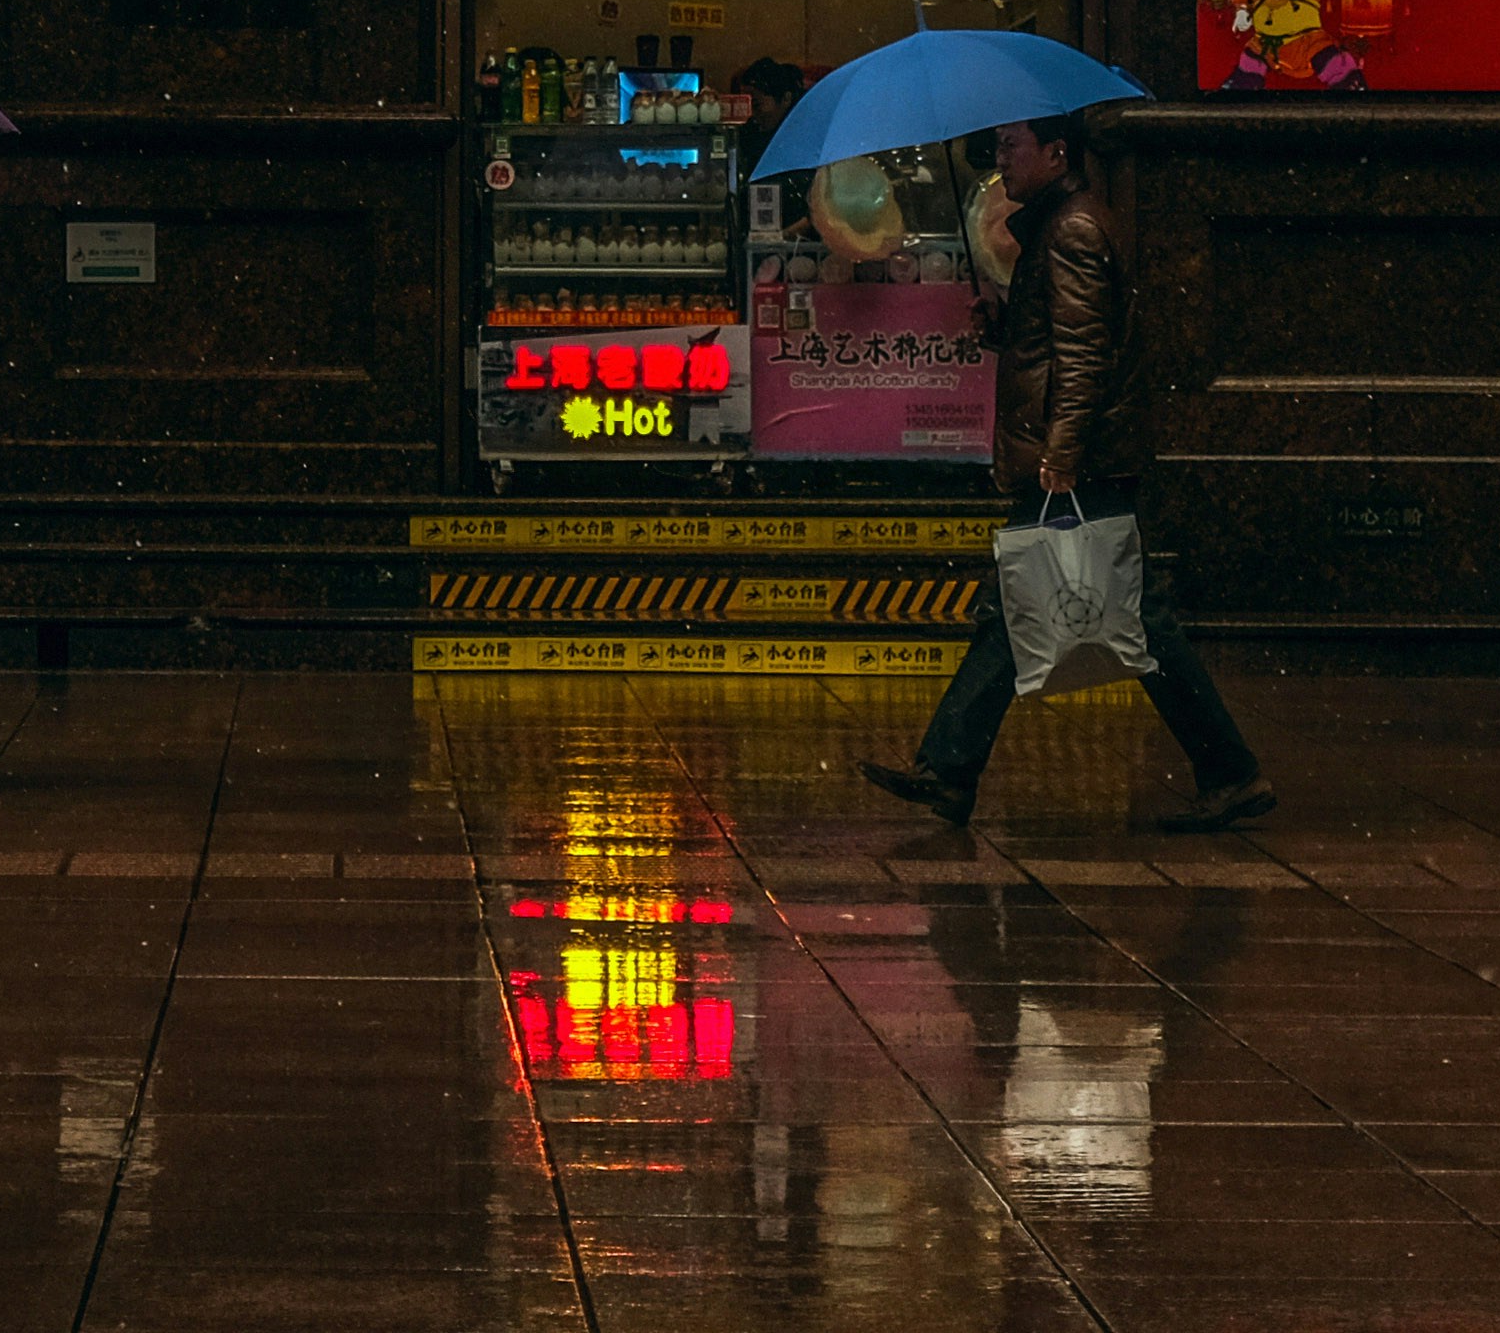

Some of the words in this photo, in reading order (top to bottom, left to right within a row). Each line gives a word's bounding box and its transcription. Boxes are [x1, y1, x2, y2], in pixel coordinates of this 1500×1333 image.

[769, 332, 984, 368] 上海艺术棉花糖
[505, 345, 731, 392] 上海老酸奶
[791, 374, 850, 390] Shanghai
[874, 374, 915, 387] Cotton
[917, 374, 960, 390] Candy
[605, 398, 674, 437] Hot
[450, 520, 508, 535] 小心台阶
[557, 520, 615, 535] 小心台阶
[652, 520, 711, 536] 小心台阶
[750, 521, 808, 536] 小心台阶
[860, 522, 918, 537] 小心台阶
[957, 523, 999, 537] 小心台
[768, 584, 829, 600] 小心台阶
[452, 642, 512, 658] 小心台阶
[566, 642, 626, 659] 小心台阶
[665, 643, 727, 660] 小心台阶
[766, 644, 827, 661] 小心台阶
[882, 646, 944, 663] 小心台阶
